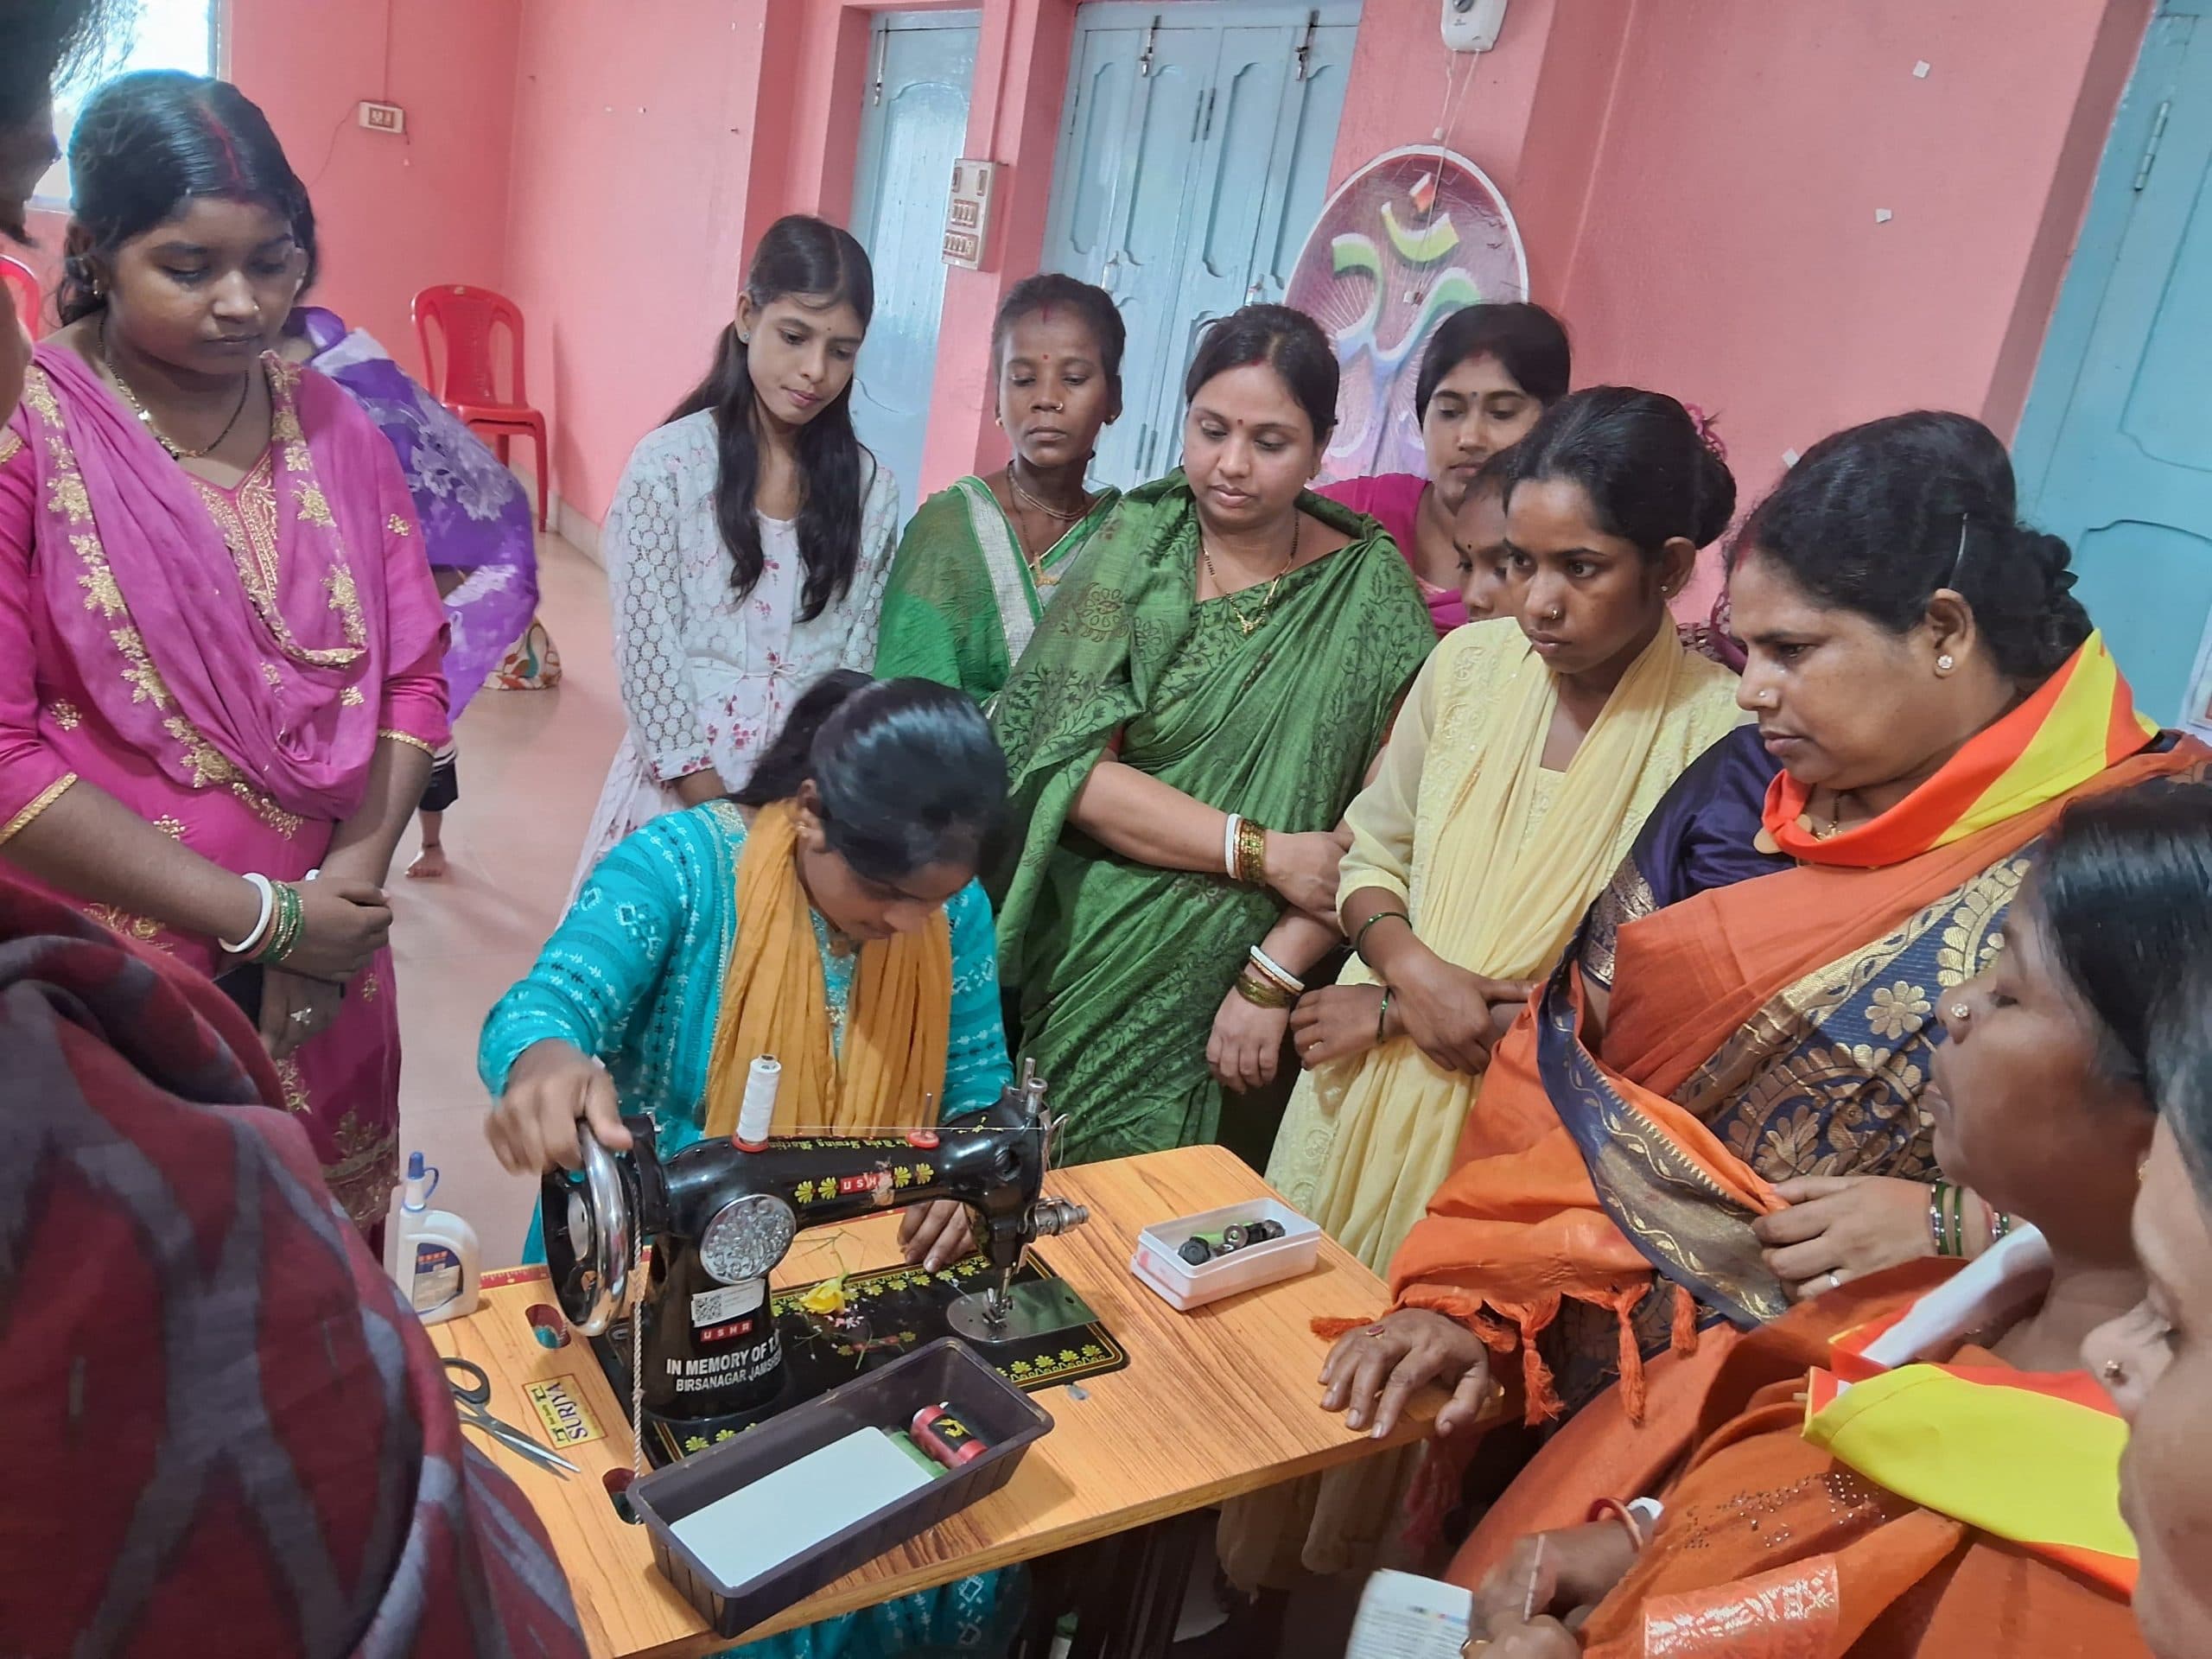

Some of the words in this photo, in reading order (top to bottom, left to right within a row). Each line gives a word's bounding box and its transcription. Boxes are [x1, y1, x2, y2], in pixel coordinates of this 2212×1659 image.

[767, 1139, 813, 1152] Machin
[843, 1174, 888, 1190] USH
[703, 1322, 750, 1338] USHA
[666, 1358, 682, 1376] IN
[685, 1349, 750, 1376] MEMORY
[751, 1342, 767, 1362] OF
[676, 1370, 747, 1392] BIRSANAGAR
[545, 1382, 588, 1440] SURJYA
